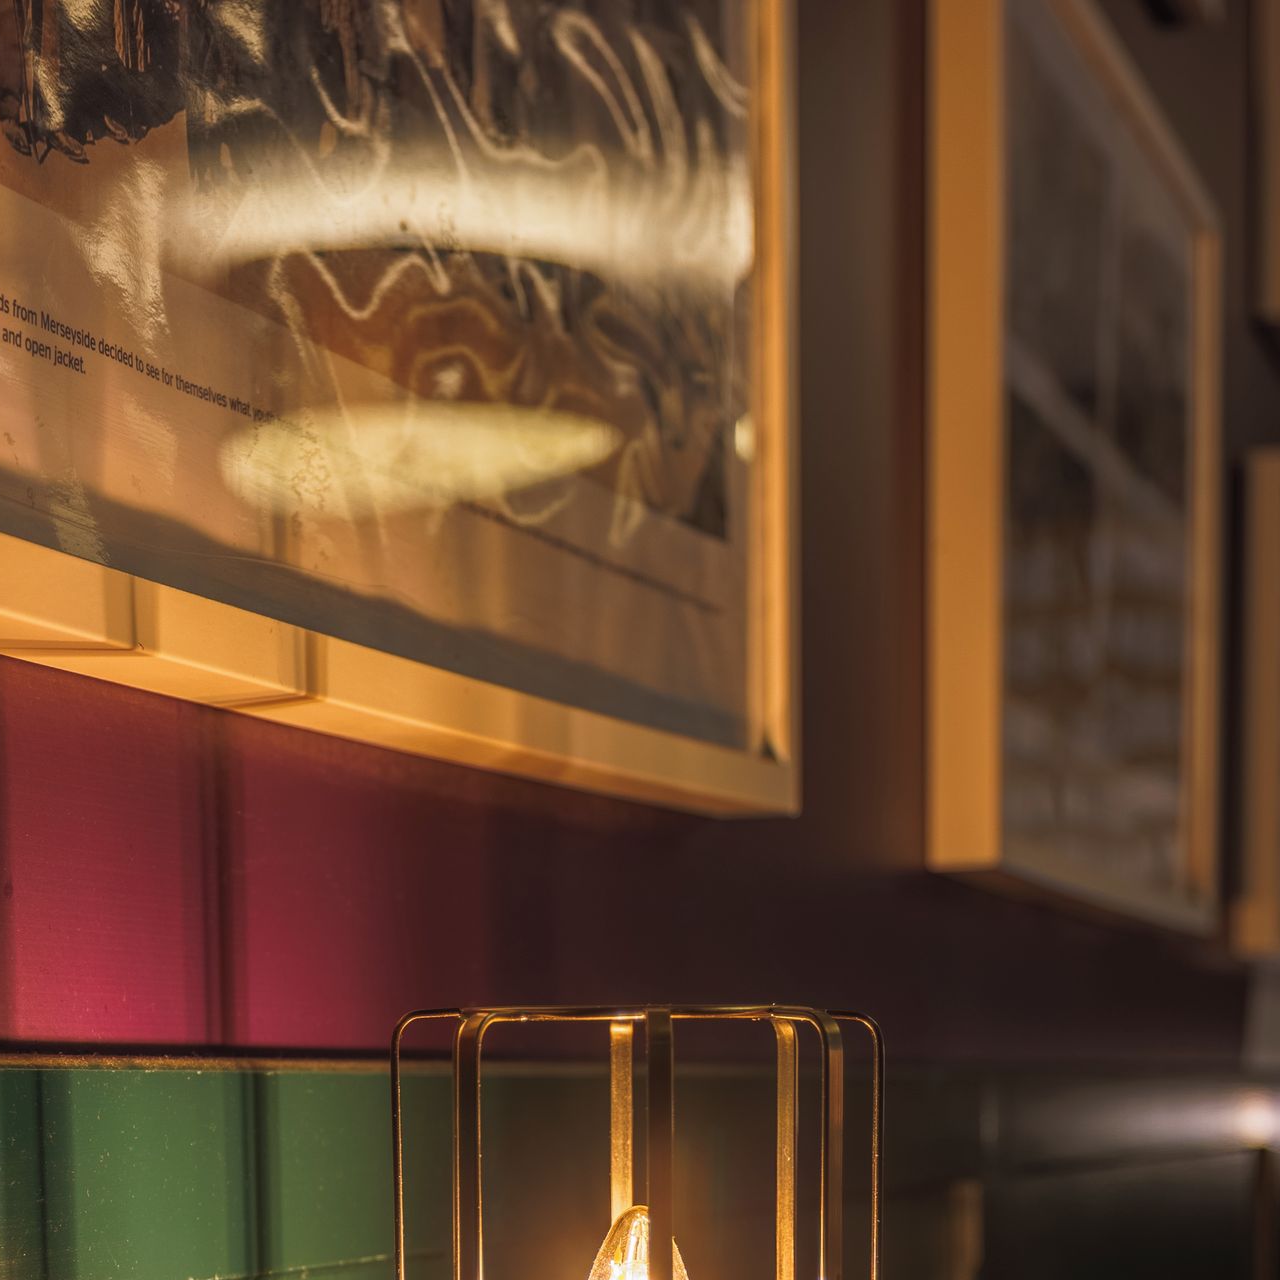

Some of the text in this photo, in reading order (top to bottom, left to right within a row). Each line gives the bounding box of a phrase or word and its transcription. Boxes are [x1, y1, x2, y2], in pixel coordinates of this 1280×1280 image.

[2, 327, 21, 348] and
[25, 337, 51, 361] open
[53, 345, 86, 374] jacket.
[12, 299, 38, 326] from
[40, 311, 96, 351] Merseyside
[98, 338, 134, 368] decided
[135, 355, 144, 373] to
[146, 363, 160, 382] see
[161, 368, 174, 387] for
[176, 374, 228, 408] themselves
[229, 397, 252, 418] what
